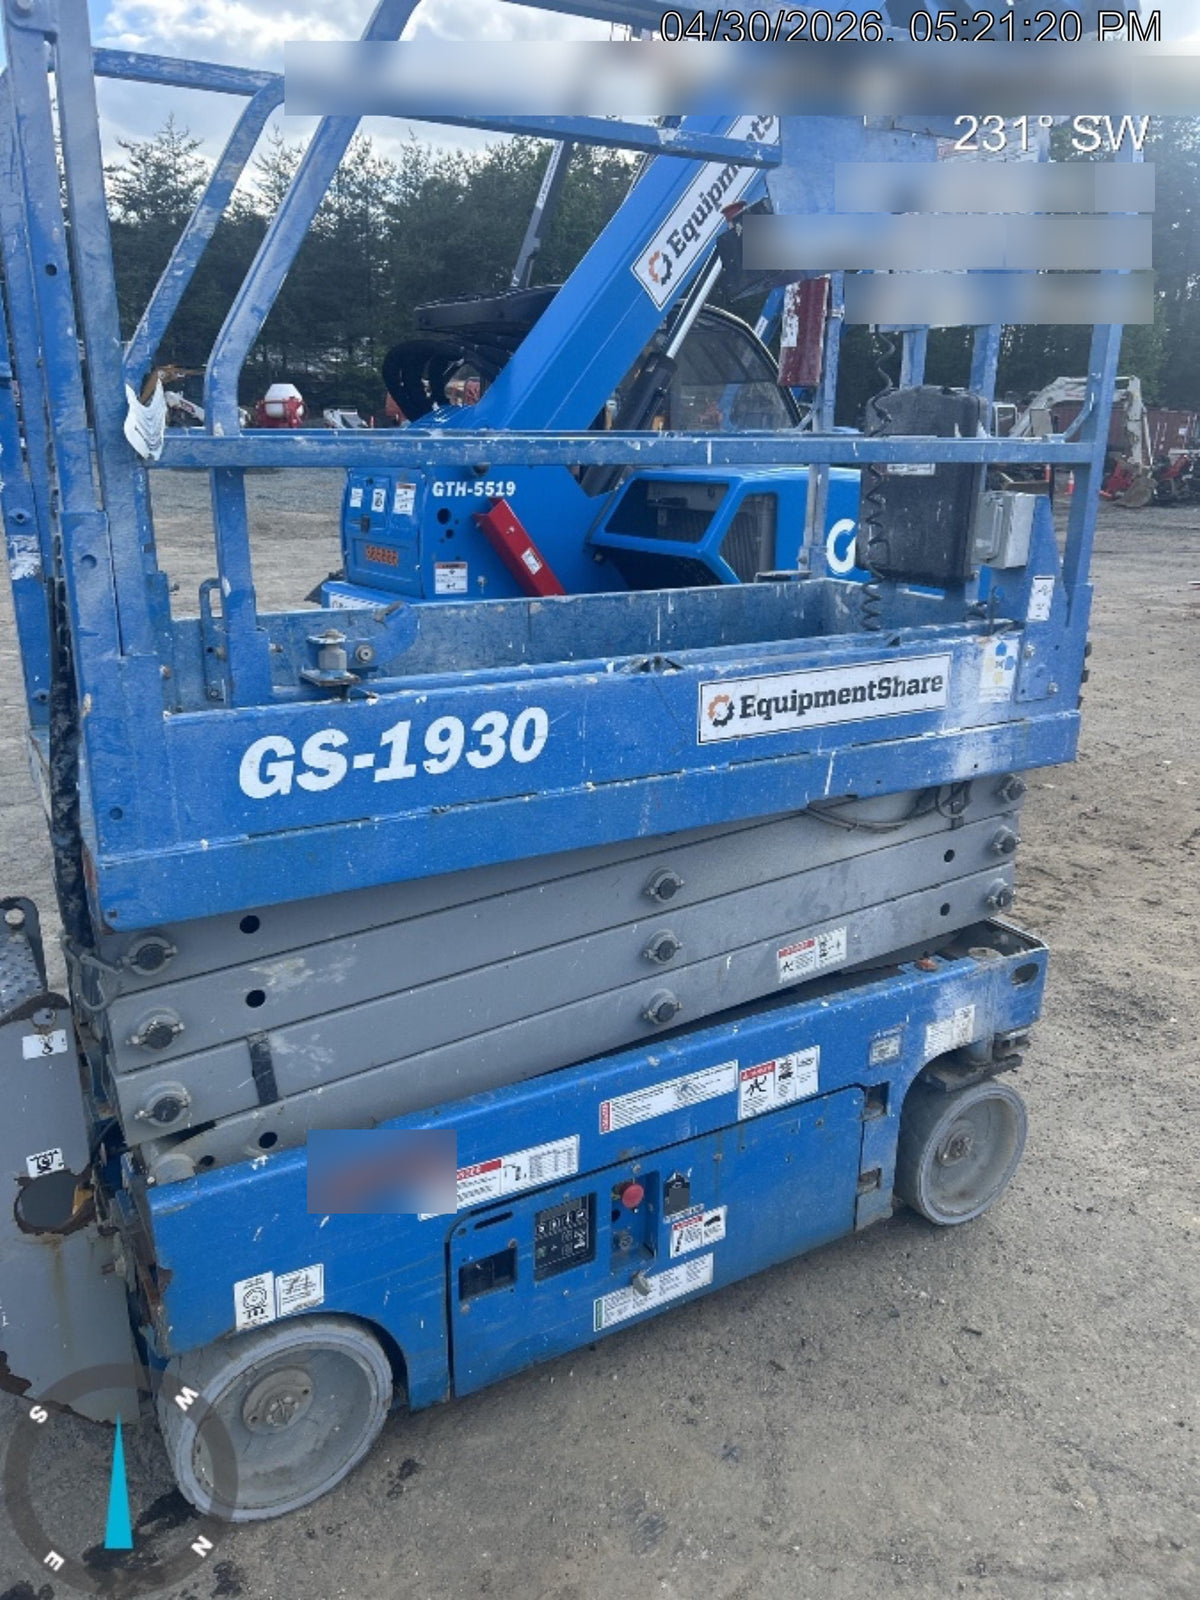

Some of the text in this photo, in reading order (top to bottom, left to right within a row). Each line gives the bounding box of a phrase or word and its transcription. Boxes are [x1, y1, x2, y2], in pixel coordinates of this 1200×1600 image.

[432, 481, 516, 497] GTH-5519
[739, 675, 943, 721] EquipmentShare
[239, 707, 549, 799] GS-1930
